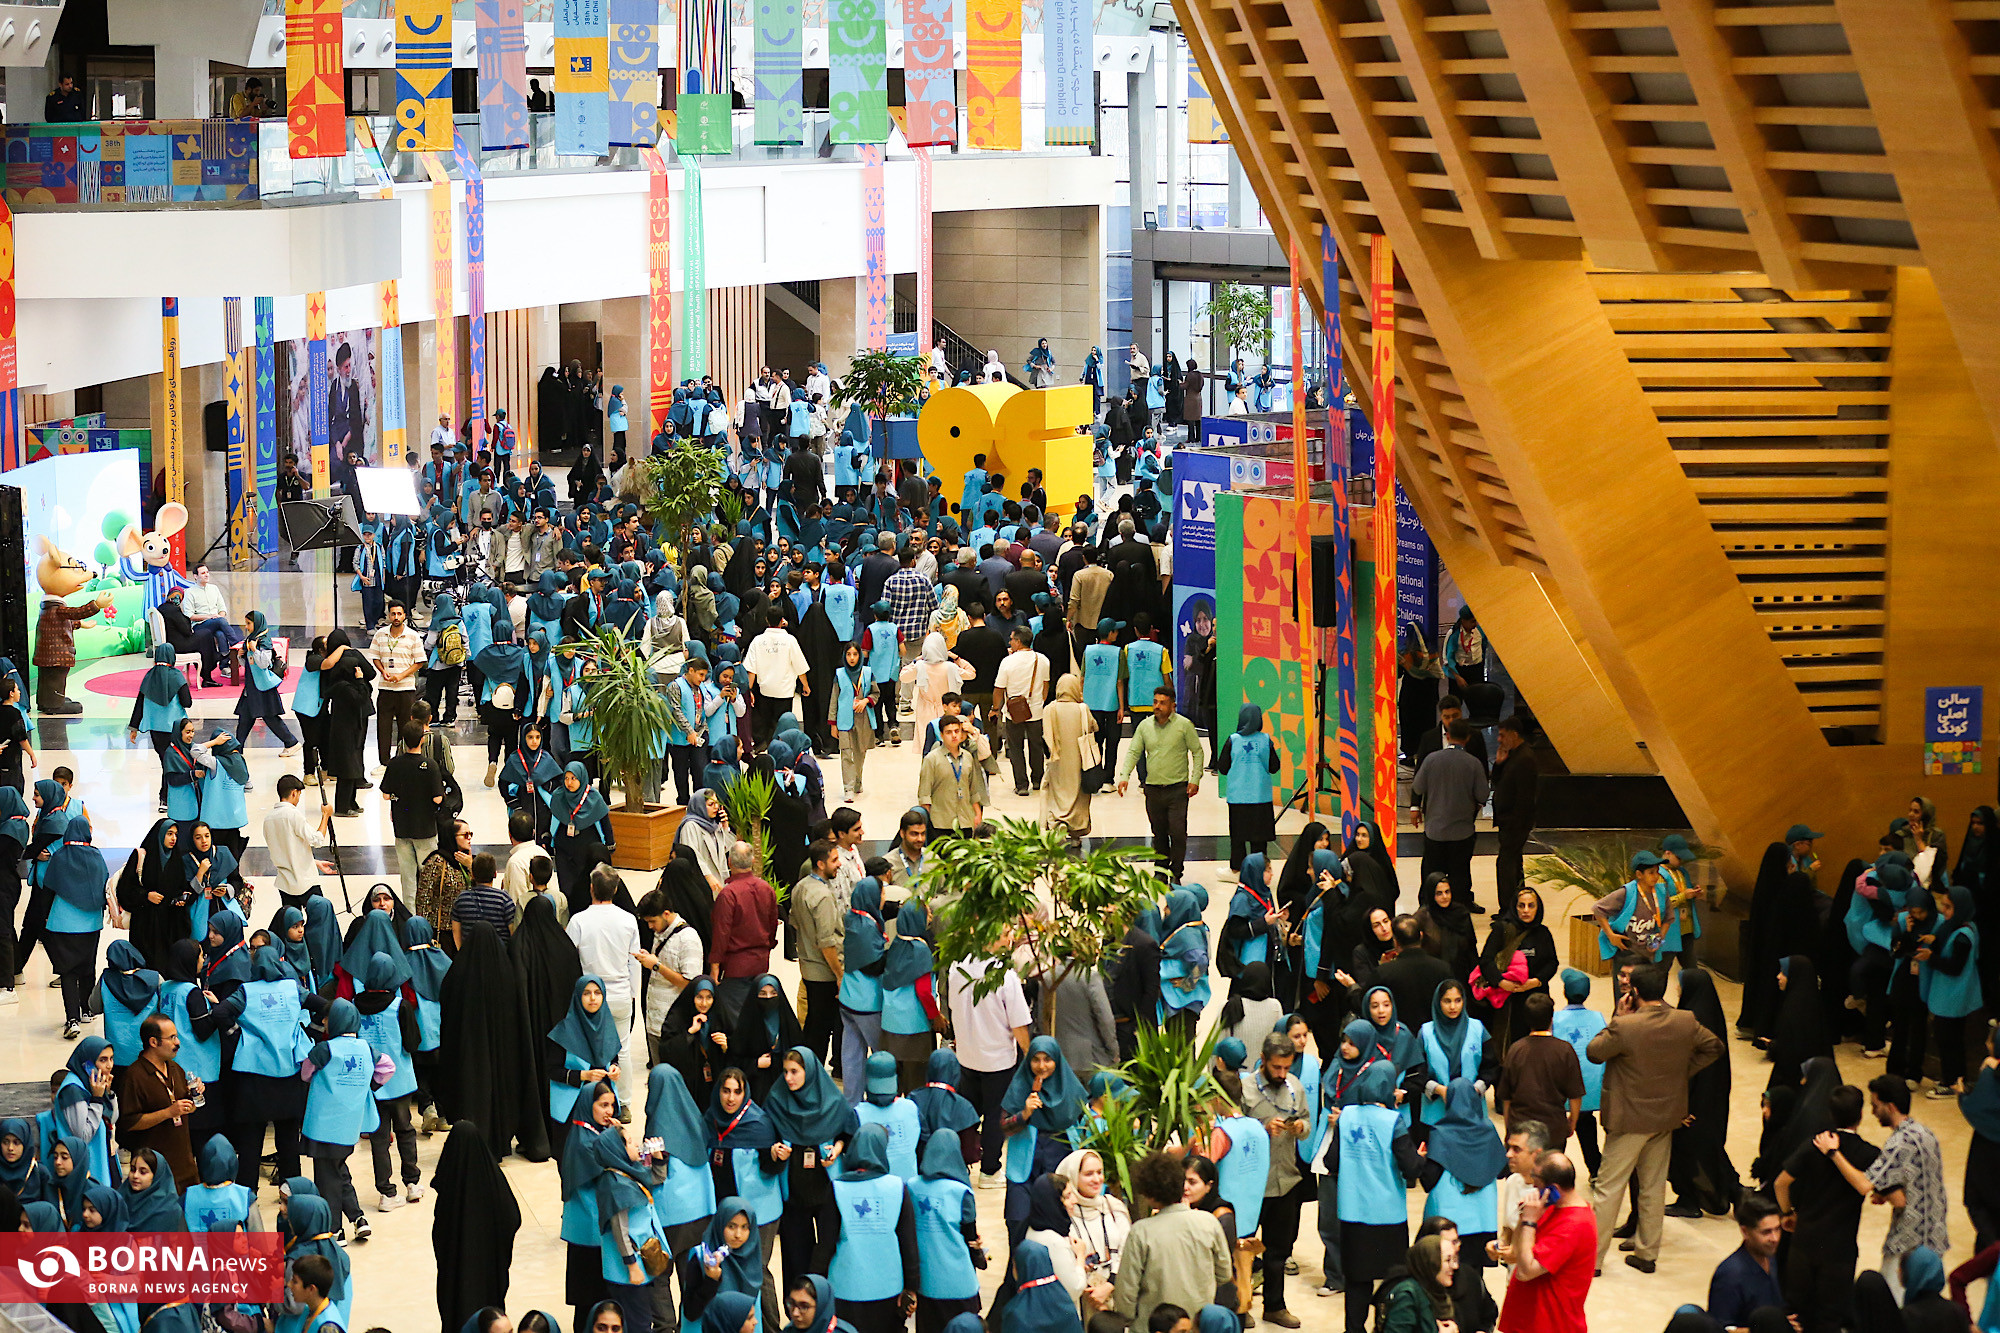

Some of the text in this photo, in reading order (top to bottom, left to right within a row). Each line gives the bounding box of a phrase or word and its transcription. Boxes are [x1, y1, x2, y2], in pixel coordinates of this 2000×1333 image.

[105, 139, 121, 148] 38th
[168, 389, 177, 418] کودکان
[1355, 429, 1368, 441] جهان
[1417, 543, 1424, 551] on
[1405, 554, 1424, 566] Screen
[1398, 590, 1424, 606] Festival
[1937, 693, 1970, 709] سالن
[1937, 707, 1968, 724] اصلی
[1936, 721, 1969, 737] کودک
